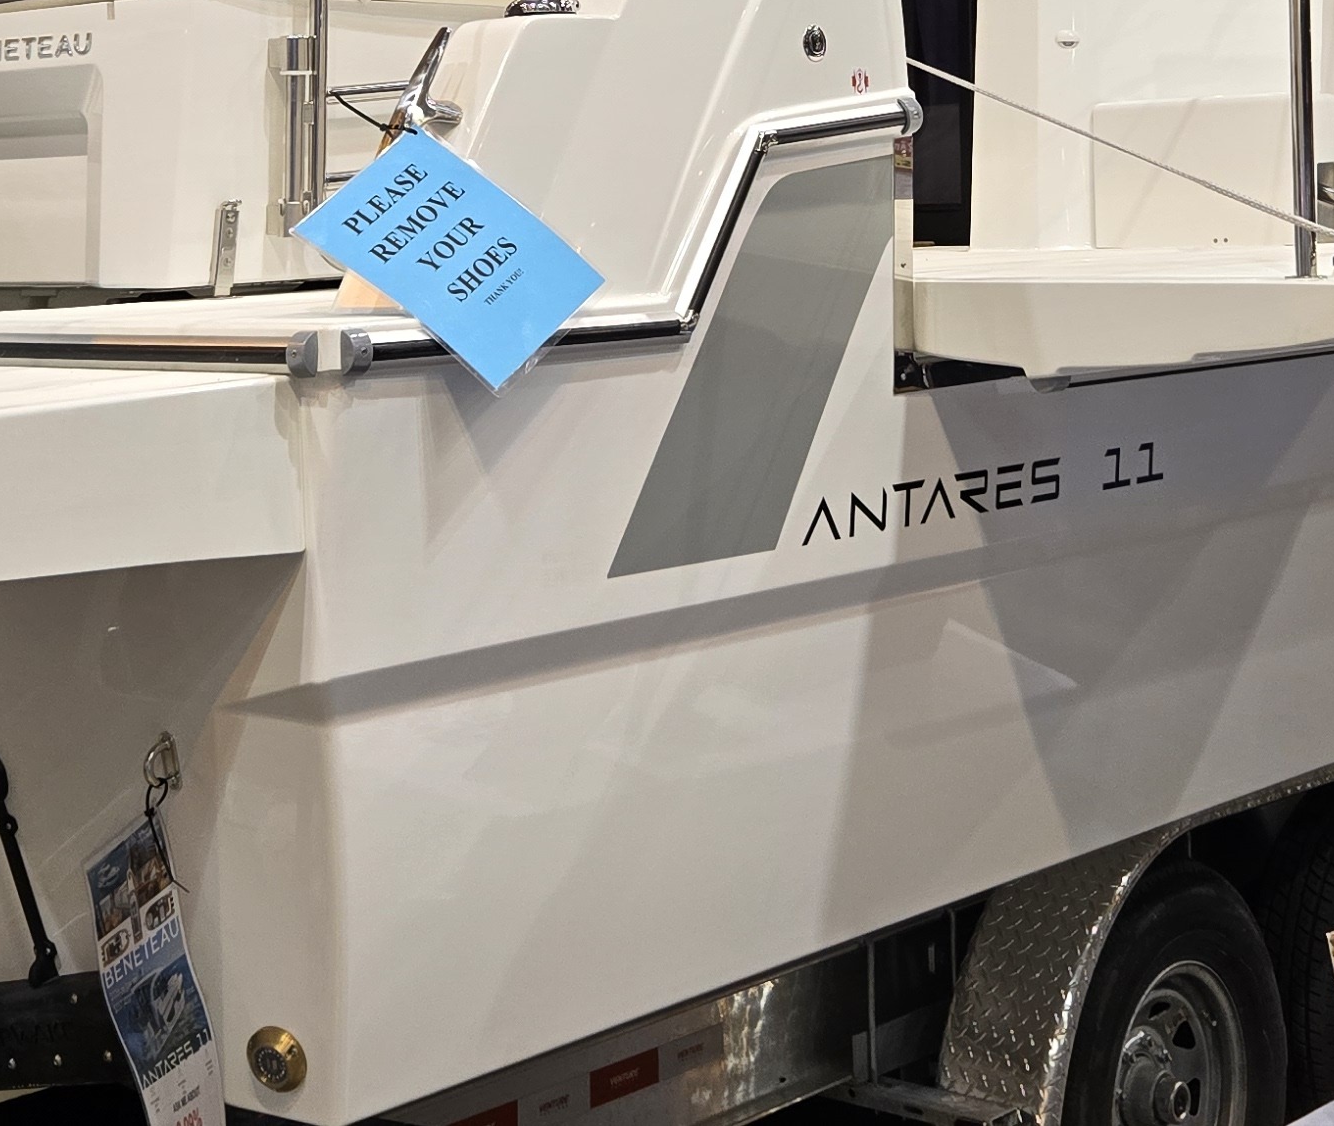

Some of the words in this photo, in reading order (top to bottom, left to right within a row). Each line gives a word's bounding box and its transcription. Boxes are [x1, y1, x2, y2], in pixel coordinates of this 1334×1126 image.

[341, 162, 429, 236] PLEASE
[368, 180, 466, 265] REMOVE
[415, 216, 486, 273] YOUR
[446, 236, 518, 303] SHOES
[483, 281, 509, 306] THANK
[504, 268, 525, 289] YOU!
[801, 456, 1061, 547] ANTARES
[1102, 441, 1164, 491] 11
[103, 915, 180, 990] BENETEAU
[142, 1040, 195, 1090] ANTARES
